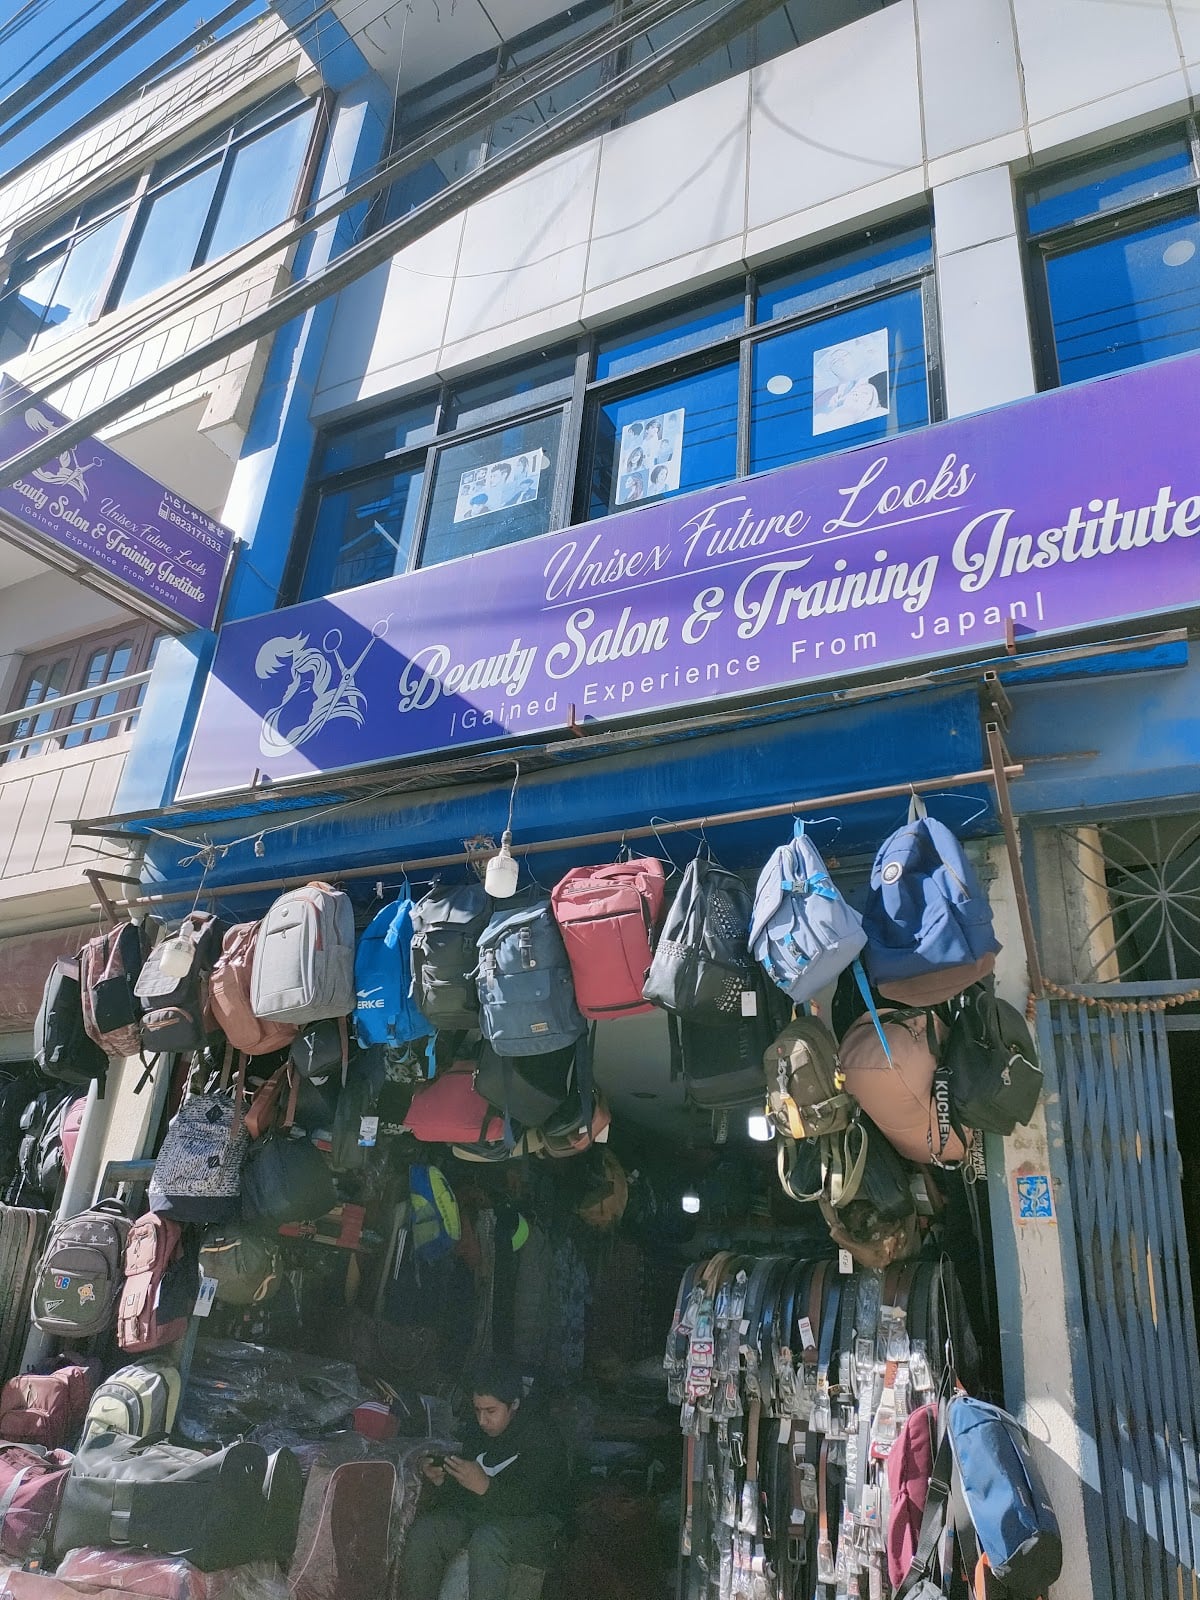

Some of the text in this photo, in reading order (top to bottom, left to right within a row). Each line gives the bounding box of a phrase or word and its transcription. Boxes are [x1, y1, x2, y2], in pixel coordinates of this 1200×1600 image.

[12, 479, 206, 603] eauty Salon & Training Institute
[65, 530, 117, 565] Experience
[123, 564, 144, 582] From
[100, 497, 207, 576] Unisex Future Looks
[169, 512, 222, 552] 9823171333
[543, 452, 977, 602] Unisex Future Looks
[398, 485, 1200, 713] Beauty Salon & Training Institute
[583, 653, 761, 705] Experience
[791, 628, 878, 663] From
[357, 999, 385, 1010] ERKE
